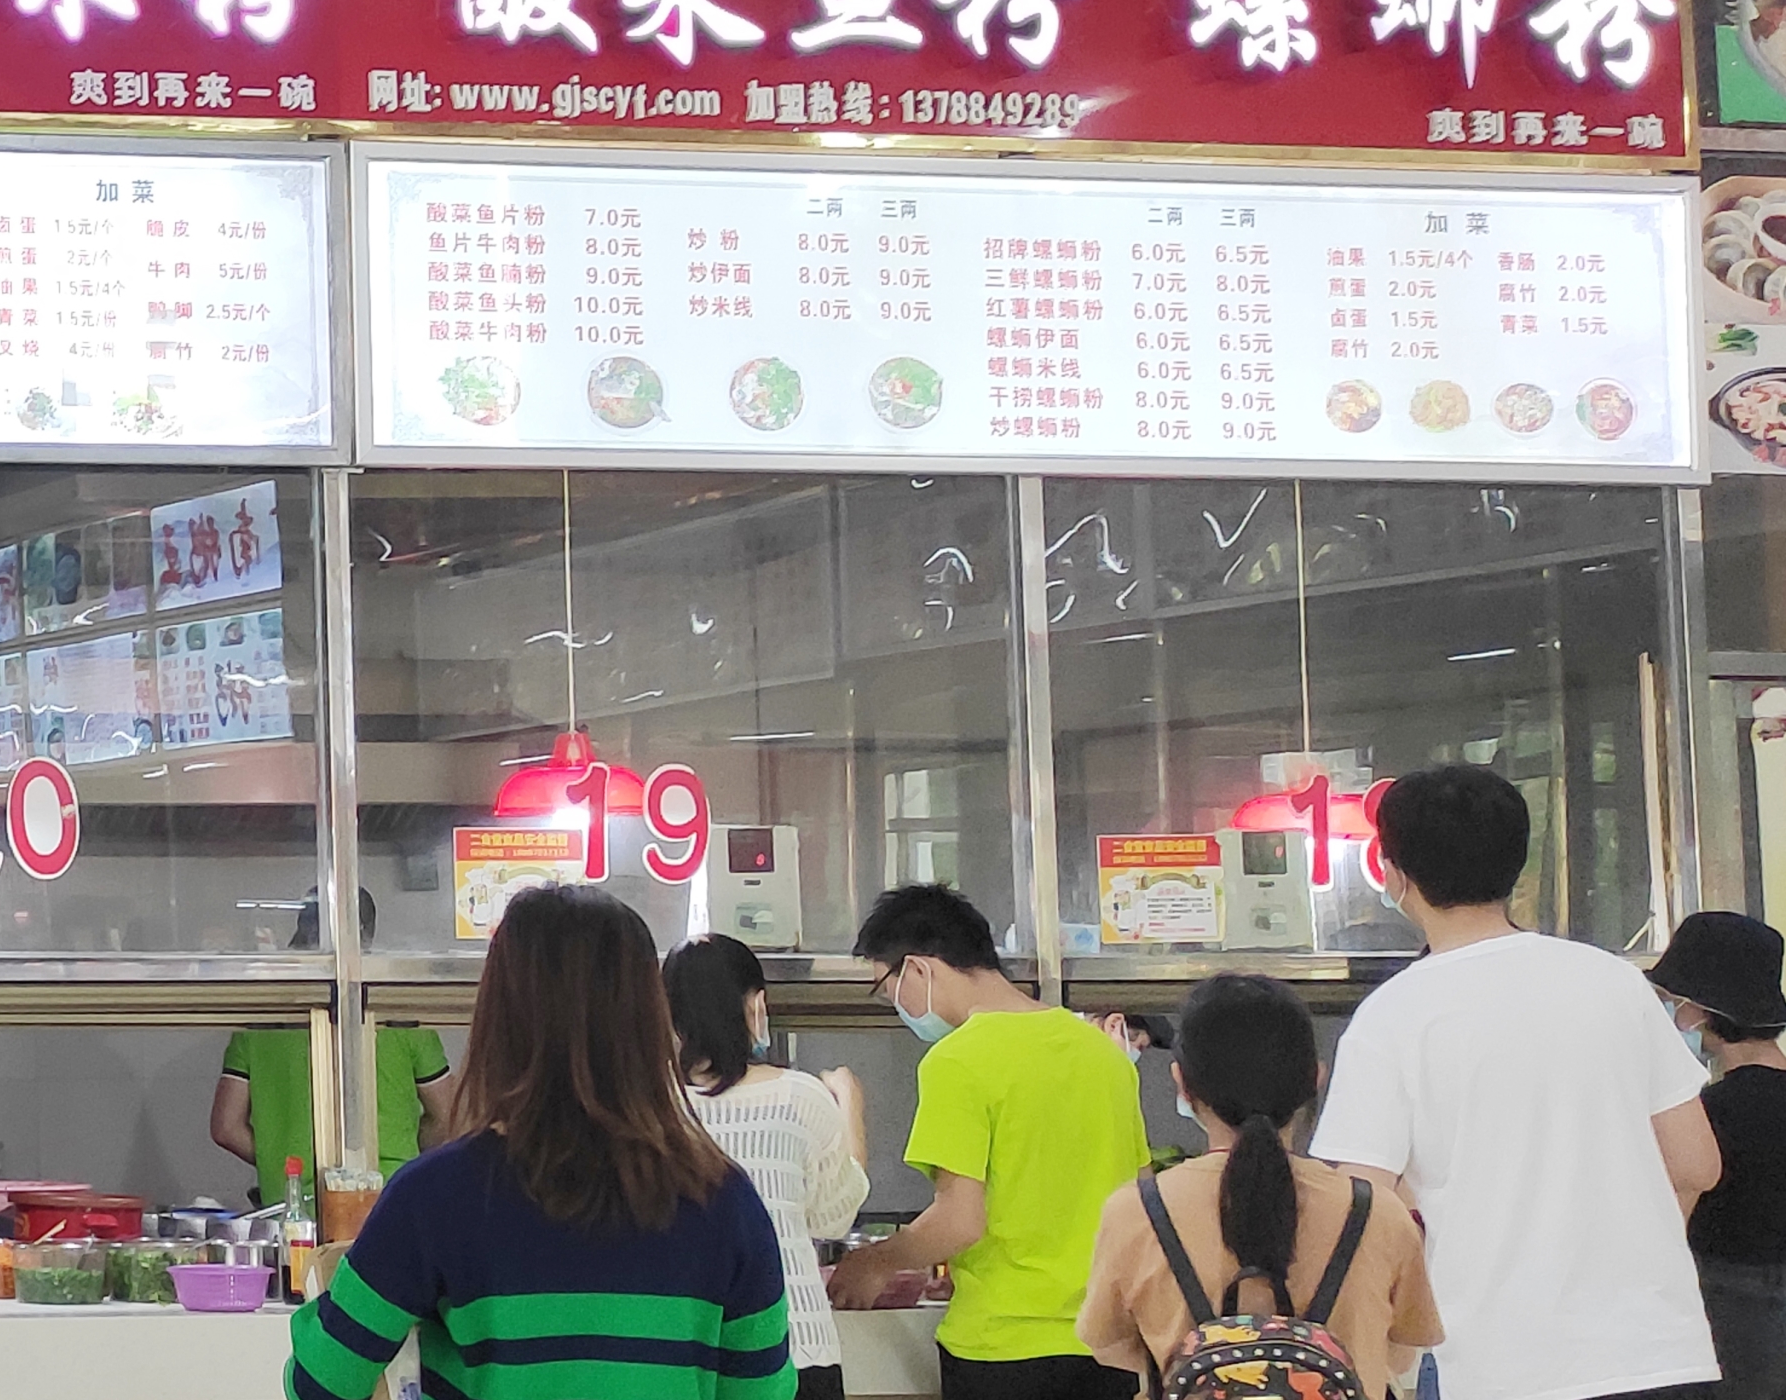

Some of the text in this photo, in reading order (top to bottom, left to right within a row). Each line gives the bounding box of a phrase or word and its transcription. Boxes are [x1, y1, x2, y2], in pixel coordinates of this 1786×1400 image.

[68, 68, 317, 113] 爽到再来一碗
[1426, 108, 1666, 150] 爽到再来一碗
[96, 179, 155, 204] 加菜
[585, 209, 641, 228] 7.0元
[1425, 211, 1491, 236] 加菜
[586, 267, 643, 287] 9.0元
[575, 297, 643, 316] 10.0元
[575, 326, 644, 345] 10.0元
[565, 761, 711, 884] 19
